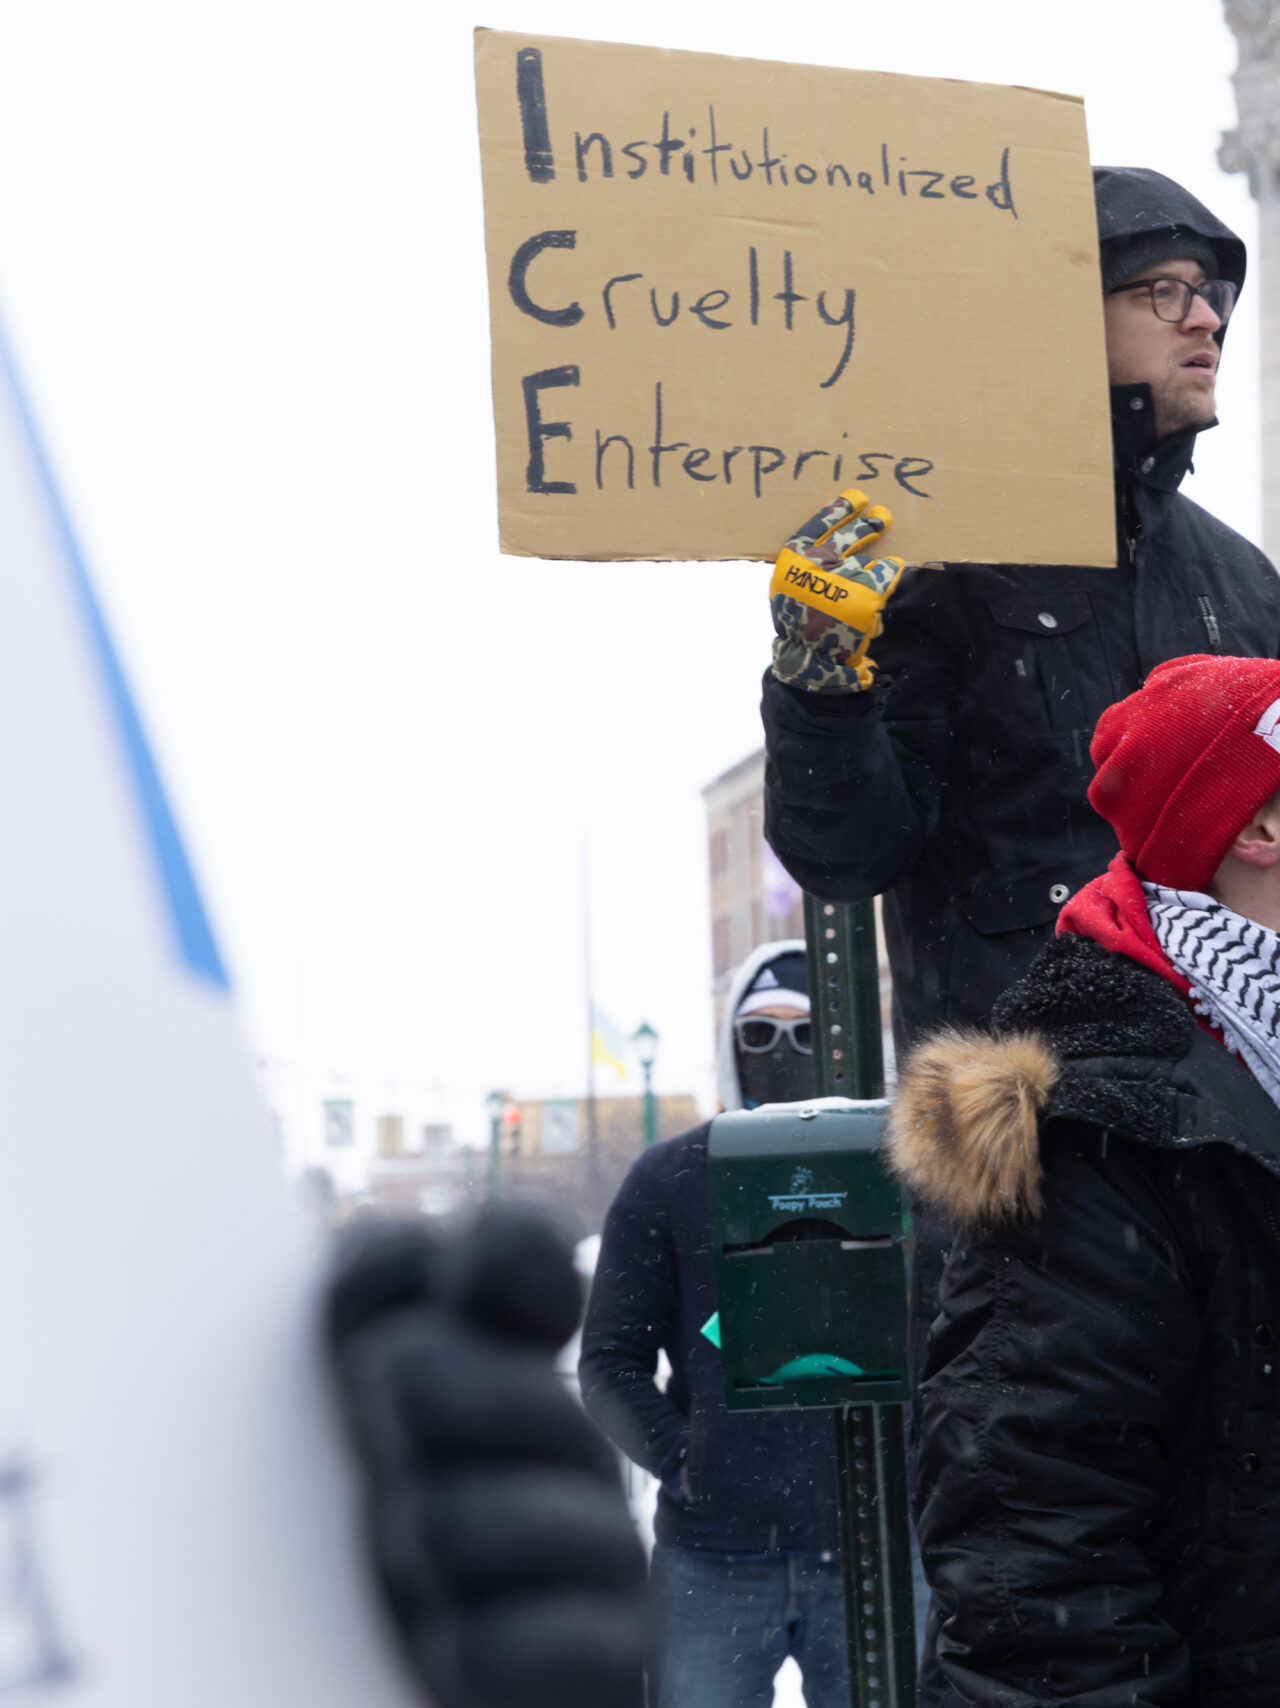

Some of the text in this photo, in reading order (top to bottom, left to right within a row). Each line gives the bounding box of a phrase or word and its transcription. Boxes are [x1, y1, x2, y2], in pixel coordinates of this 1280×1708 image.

[516, 47, 1018, 219] Institutionalized
[508, 230, 856, 388] Cruelty
[521, 365, 933, 498] Enterprise
[784, 564, 849, 603] HANDUP
